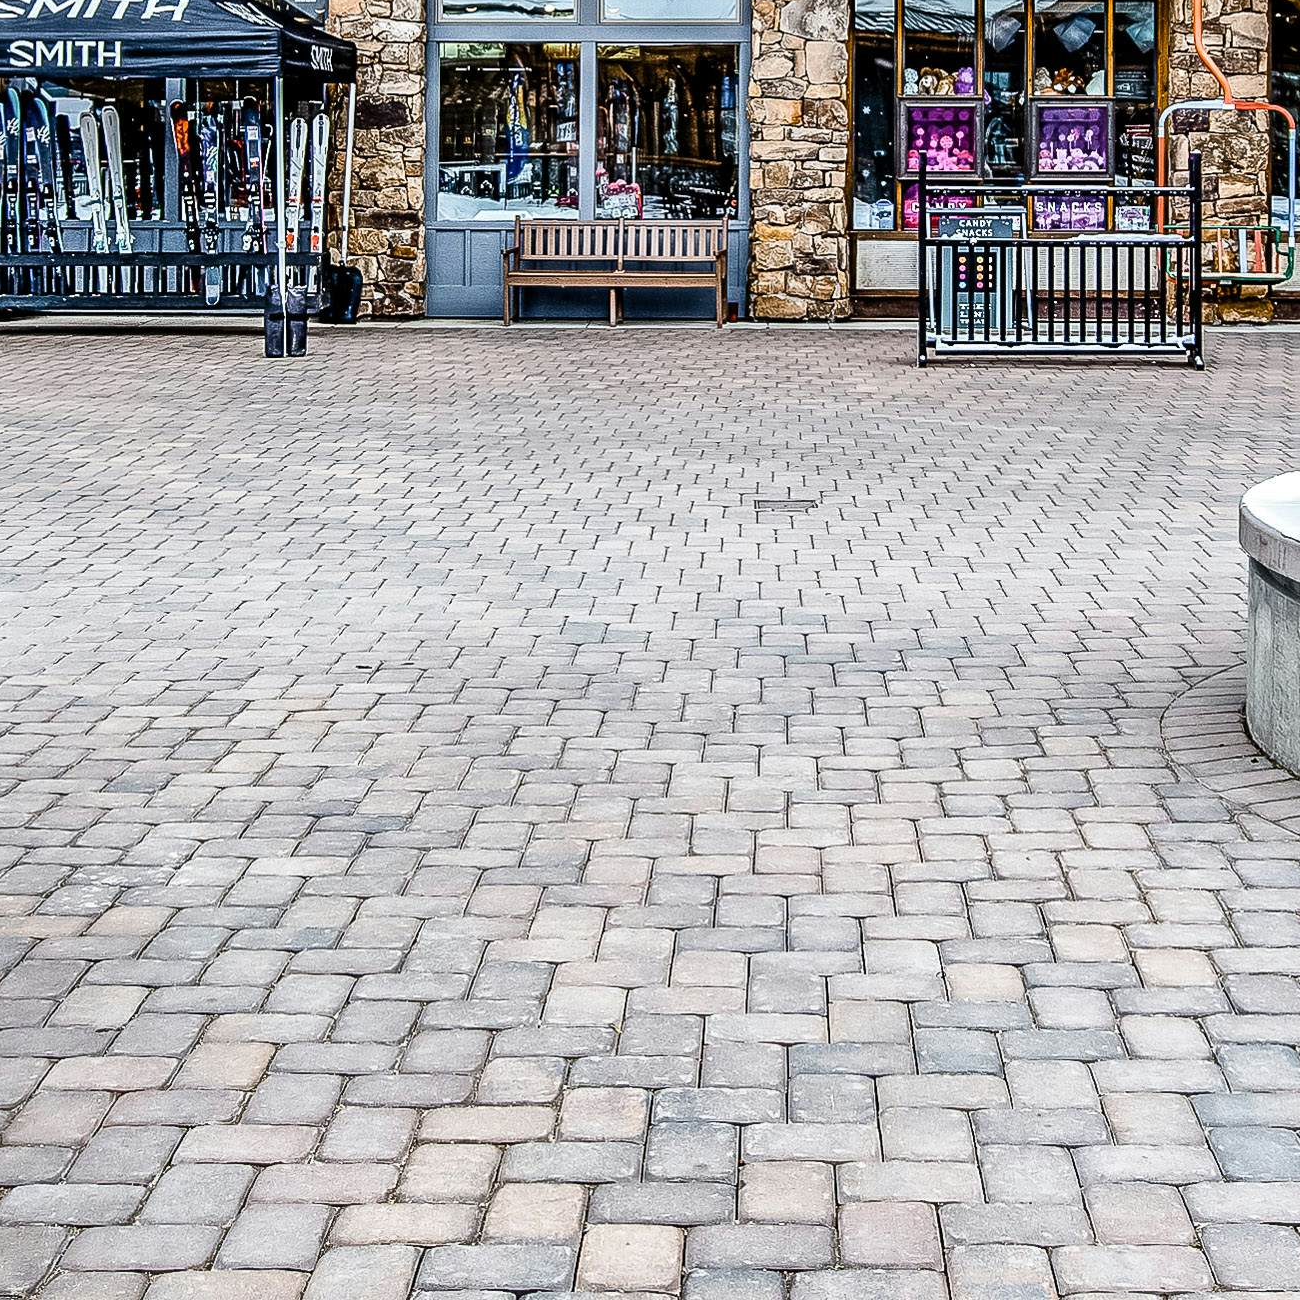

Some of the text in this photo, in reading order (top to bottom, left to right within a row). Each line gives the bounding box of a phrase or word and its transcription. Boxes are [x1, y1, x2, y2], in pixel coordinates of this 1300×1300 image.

[7, 39, 122, 68] SMITH
[310, 44, 334, 73] SMITH
[1035, 202, 1103, 212] SNACKS
[958, 219, 993, 228] CANDY
[955, 228, 994, 238] SNACKS
